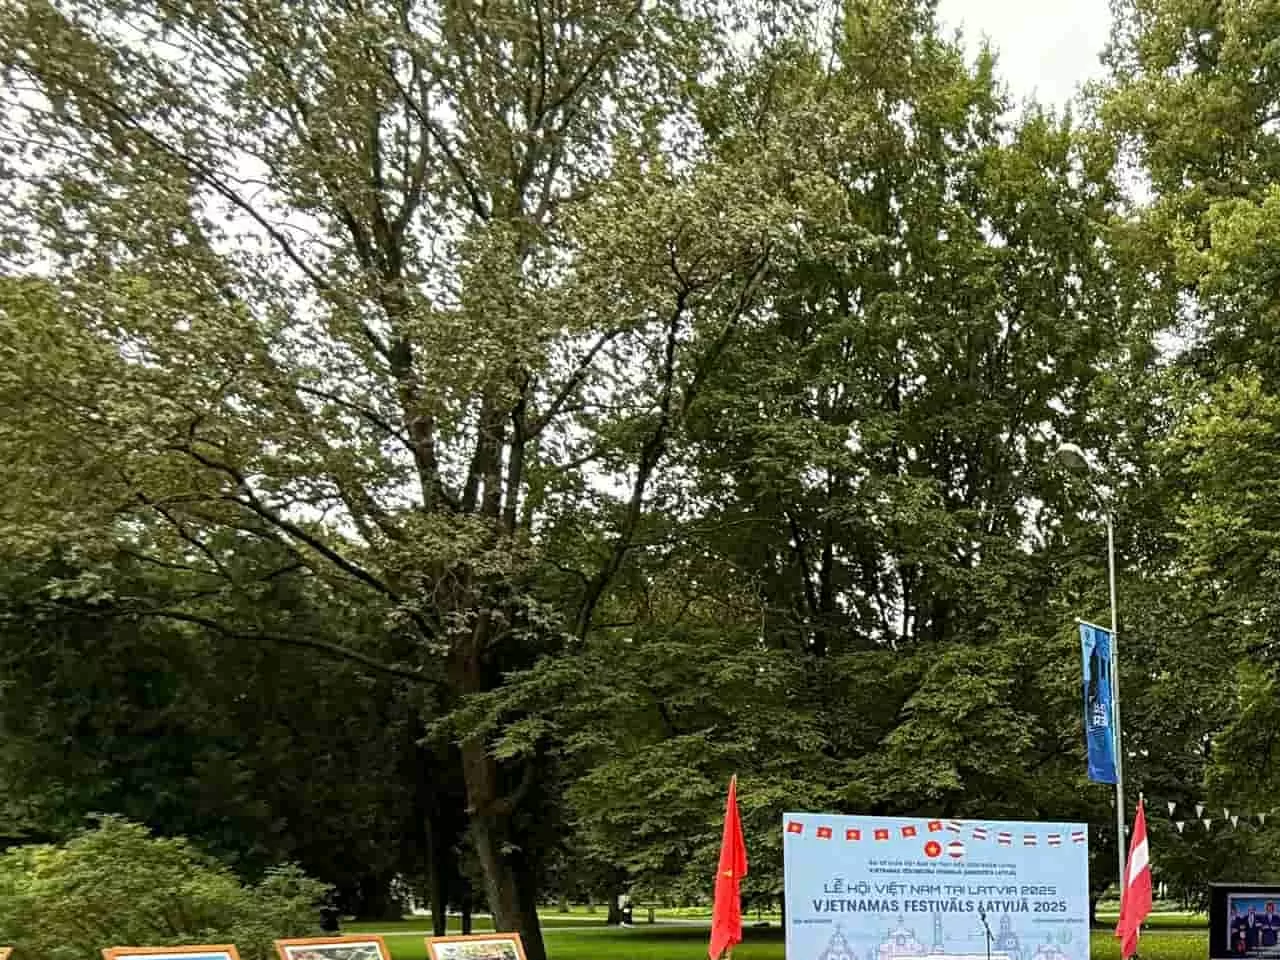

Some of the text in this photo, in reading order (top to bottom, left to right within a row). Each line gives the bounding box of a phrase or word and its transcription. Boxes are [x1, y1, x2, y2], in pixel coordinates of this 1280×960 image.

[847, 880, 871, 896] HỘI
[875, 881, 907, 896] VIỆT
[910, 885, 940, 895] NAM
[968, 885, 1017, 896] LATVIA
[1021, 886, 1057, 896] 2025
[812, 899, 899, 912] VJETNAMAS
[904, 897, 974, 913] FESTIVĀLS
[1033, 901, 1067, 913] 2025
